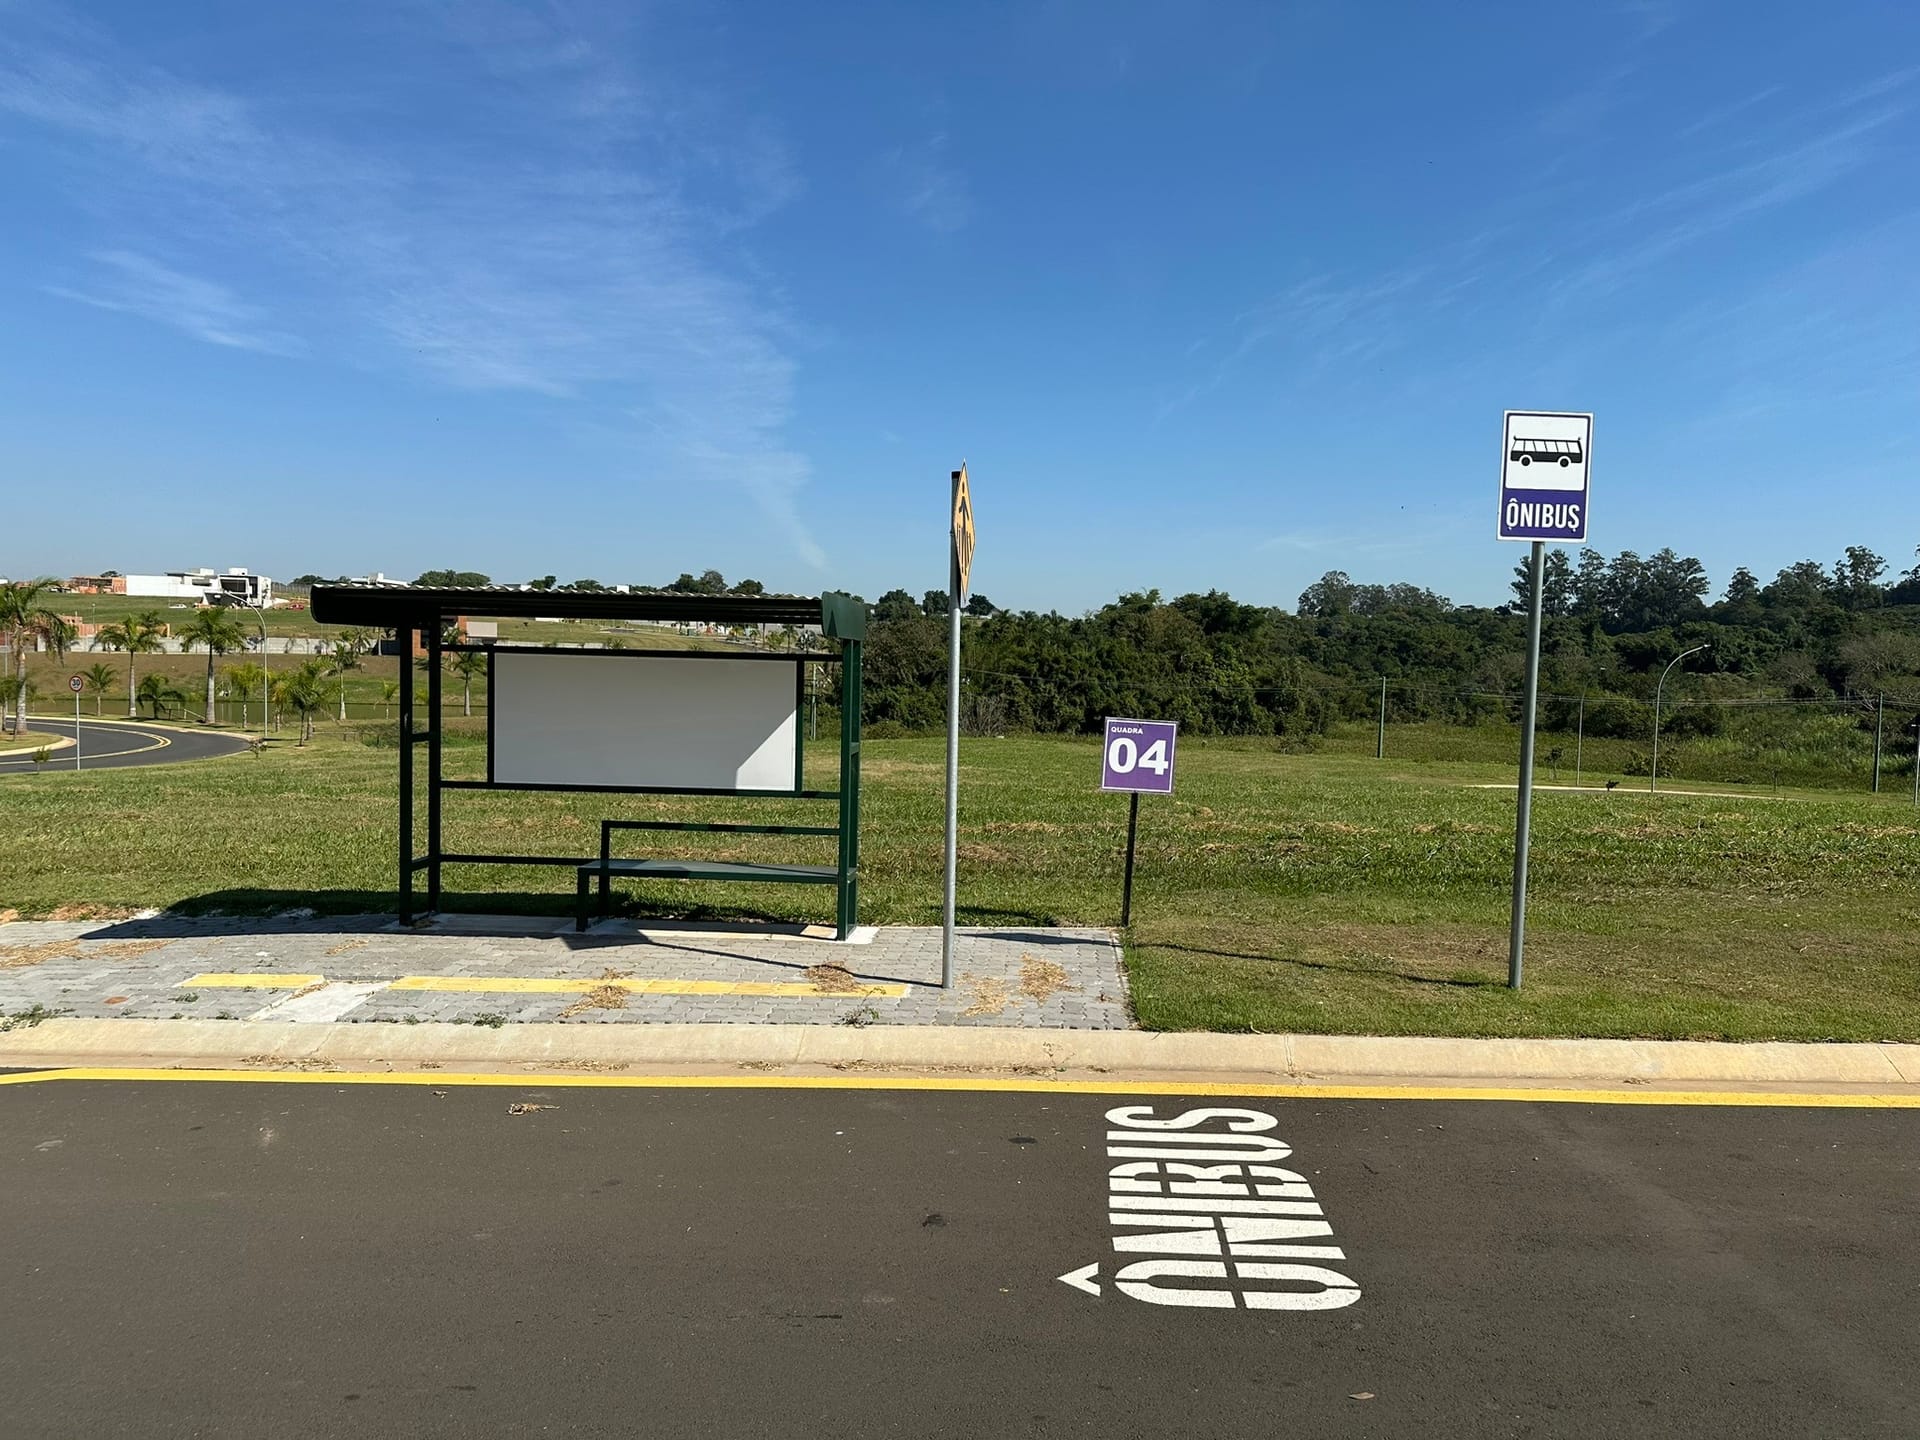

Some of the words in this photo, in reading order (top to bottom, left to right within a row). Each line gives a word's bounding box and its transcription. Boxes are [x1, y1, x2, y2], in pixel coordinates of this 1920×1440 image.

[1506, 498, 1580, 529] ÔNIBUS
[1111, 726, 1143, 734] QUADRA
[1108, 737, 1169, 775] 04
[1057, 1105, 1362, 1311] ÔNIBUS
